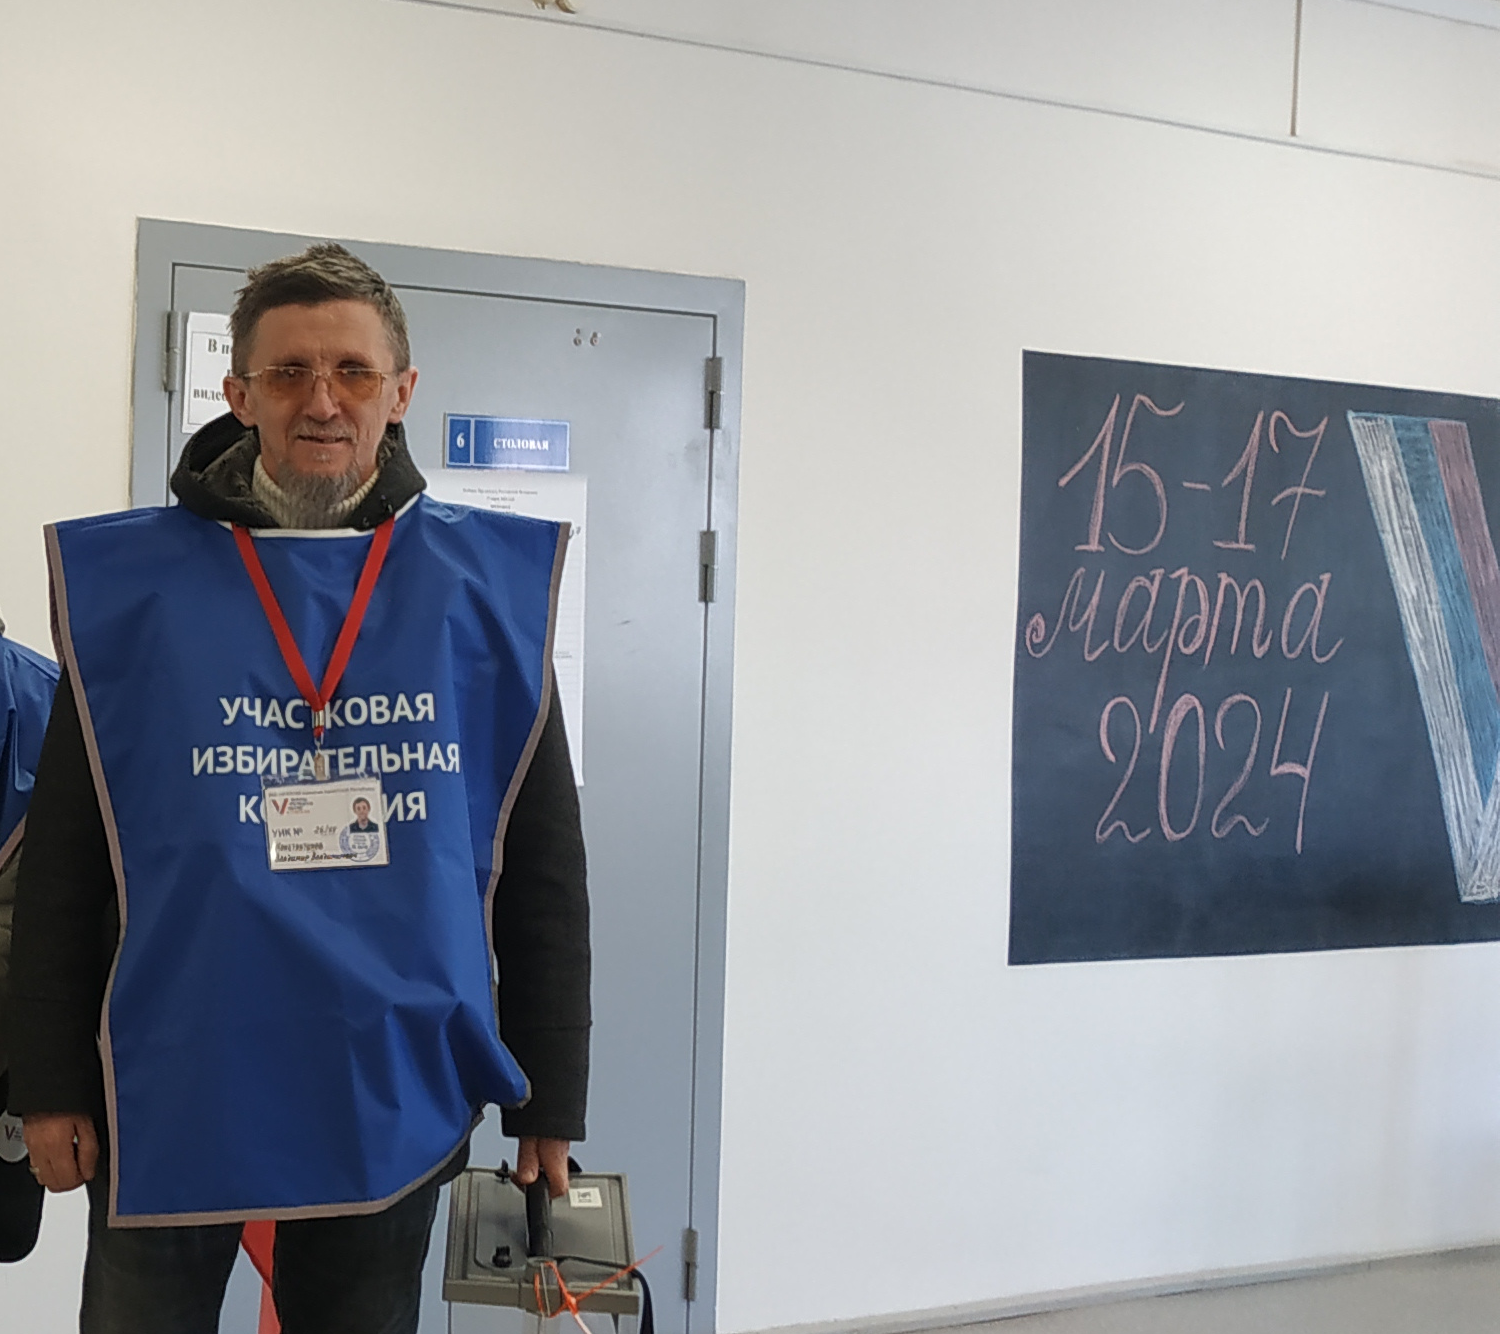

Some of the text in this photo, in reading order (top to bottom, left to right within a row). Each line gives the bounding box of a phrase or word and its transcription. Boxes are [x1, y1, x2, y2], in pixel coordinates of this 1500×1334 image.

[456, 432, 549, 451] 6 СТОЛОВАЯ
[1058, 392, 1329, 560] 15-17
[219, 693, 436, 729] УЧАСКОВАЯ
[1095, 687, 1329, 855] 2024
